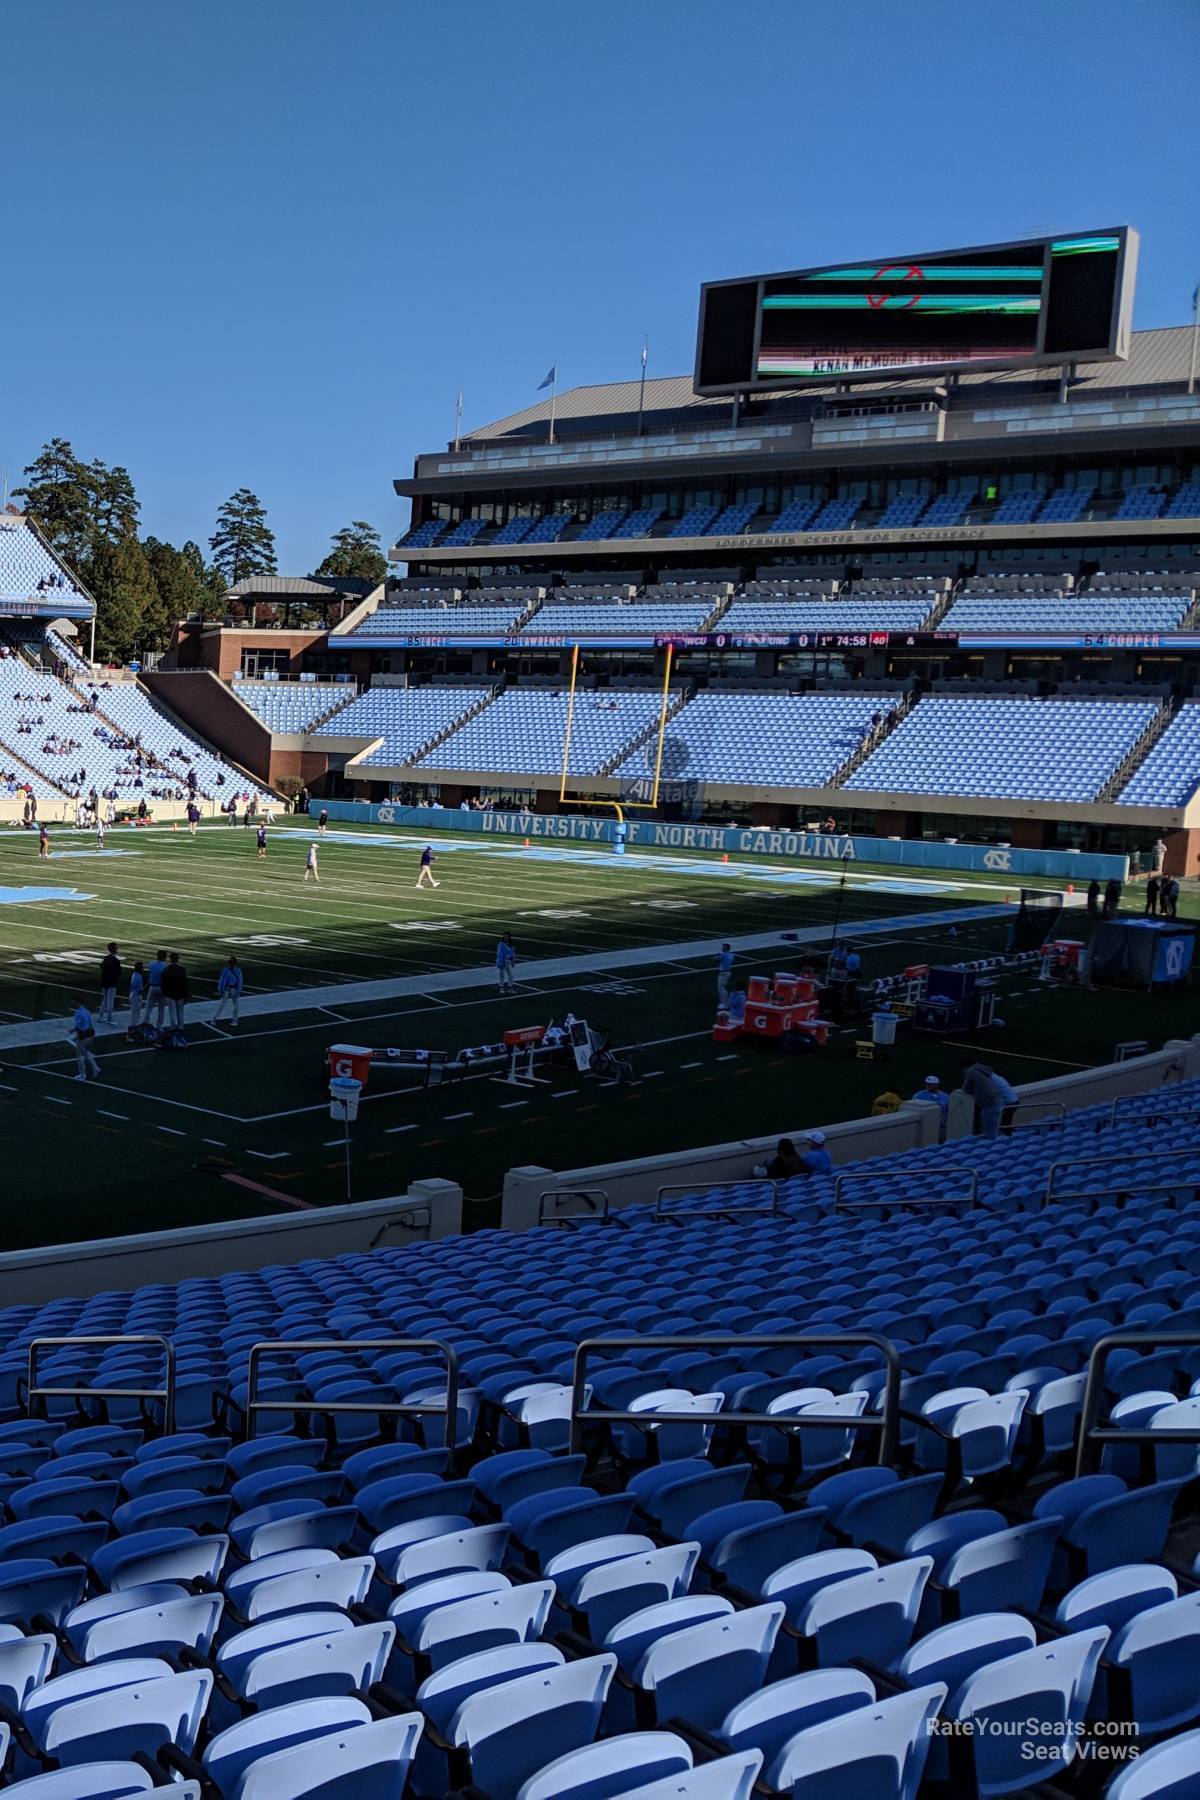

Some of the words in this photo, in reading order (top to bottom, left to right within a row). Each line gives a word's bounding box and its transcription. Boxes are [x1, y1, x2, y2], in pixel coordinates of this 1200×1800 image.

[812, 359, 848, 374] KENAN
[407, 636, 420, 647] 85
[421, 636, 448, 647] LACEY
[504, 636, 517, 647] 20
[519, 636, 567, 647] LAWRENCE
[686, 636, 707, 646] WCU
[768, 636, 790, 645] UNC
[836, 635, 867, 646] 74:58
[1108, 634, 1160, 648] COOPER
[482, 812, 604, 840] UNIVERSITY
[654, 826, 725, 849] NORTH
[739, 831, 857, 859] CAROLINA
[215, 934, 311, 947] 50
[754, 1015, 768, 1029] G
[336, 1059, 353, 1077] G
